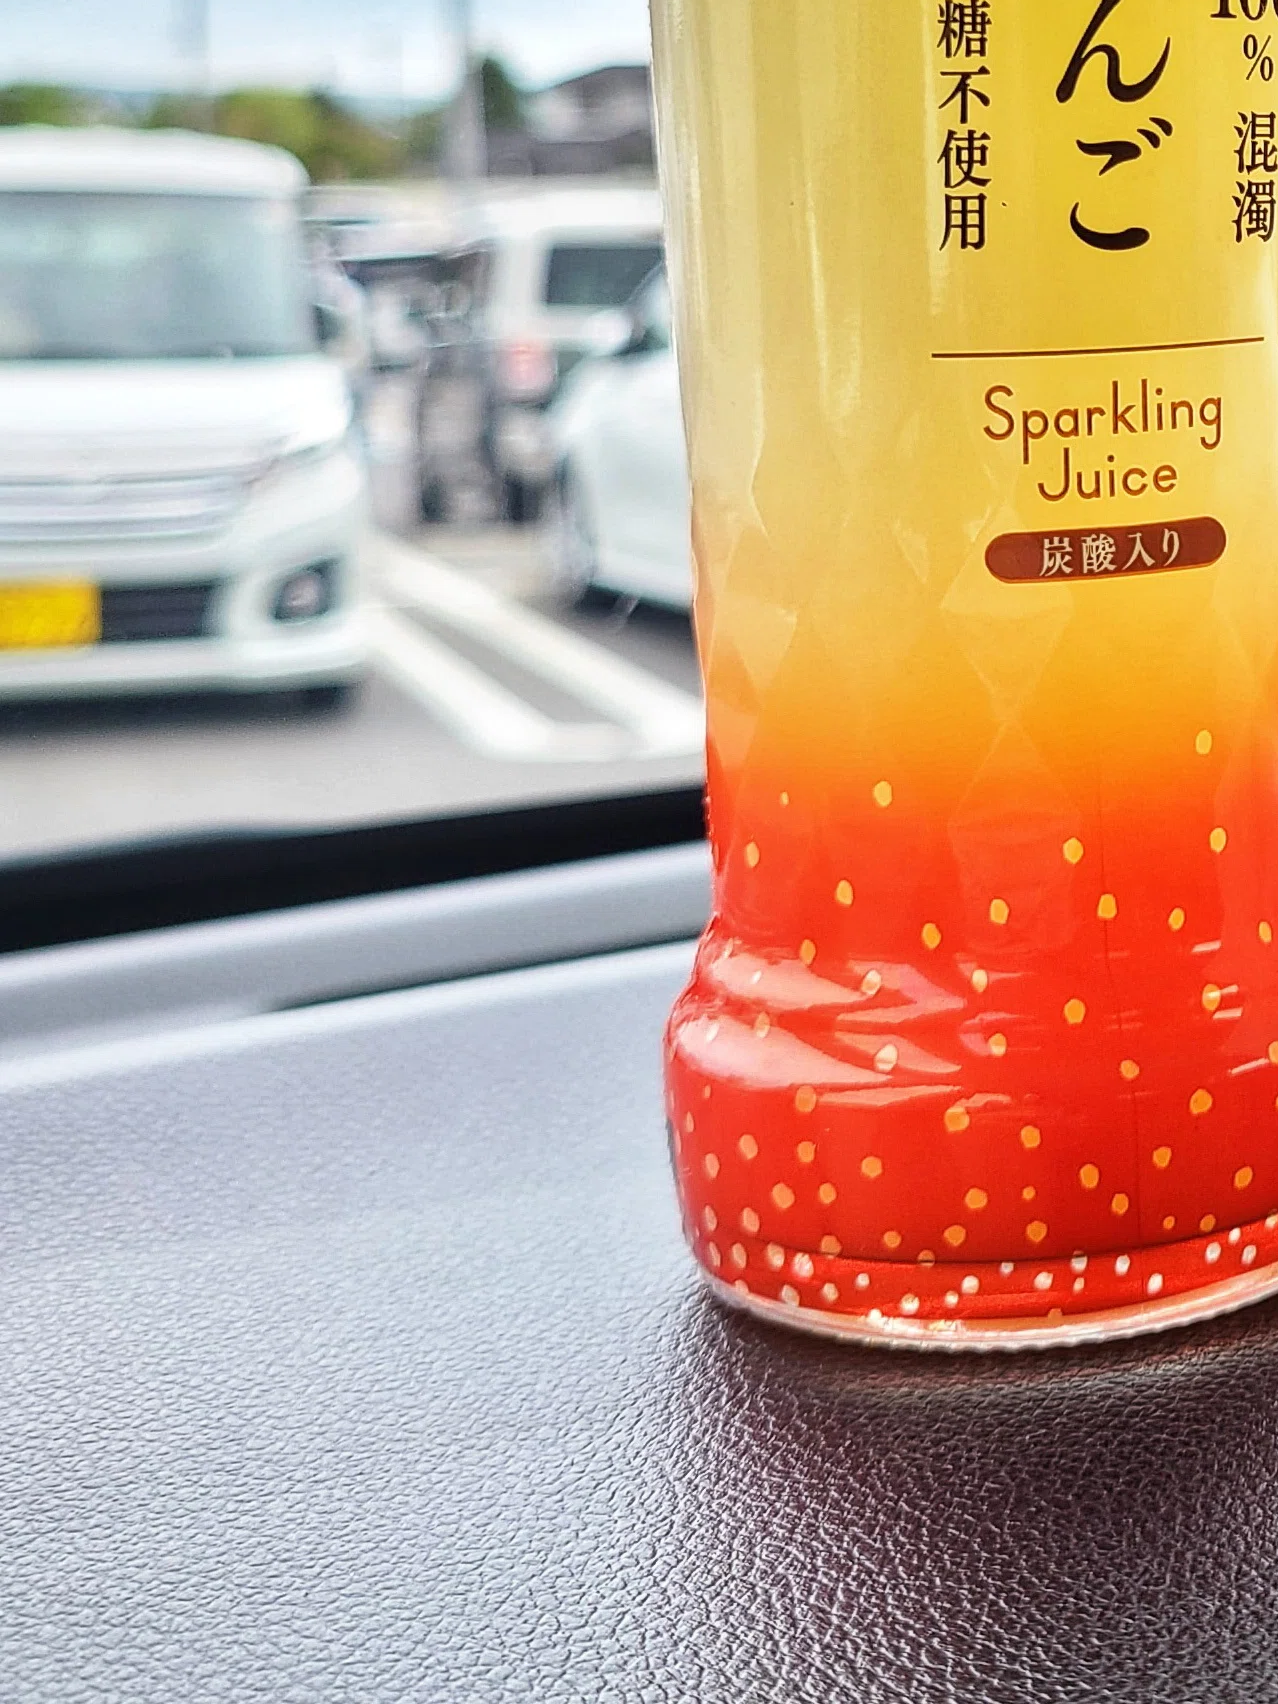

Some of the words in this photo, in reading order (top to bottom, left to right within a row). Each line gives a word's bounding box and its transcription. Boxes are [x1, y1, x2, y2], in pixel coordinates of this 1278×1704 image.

[983, 378, 1223, 465] Sparkling
[1037, 447, 1178, 502] Juice
[1039, 527, 1181, 578] 炭酸入り
